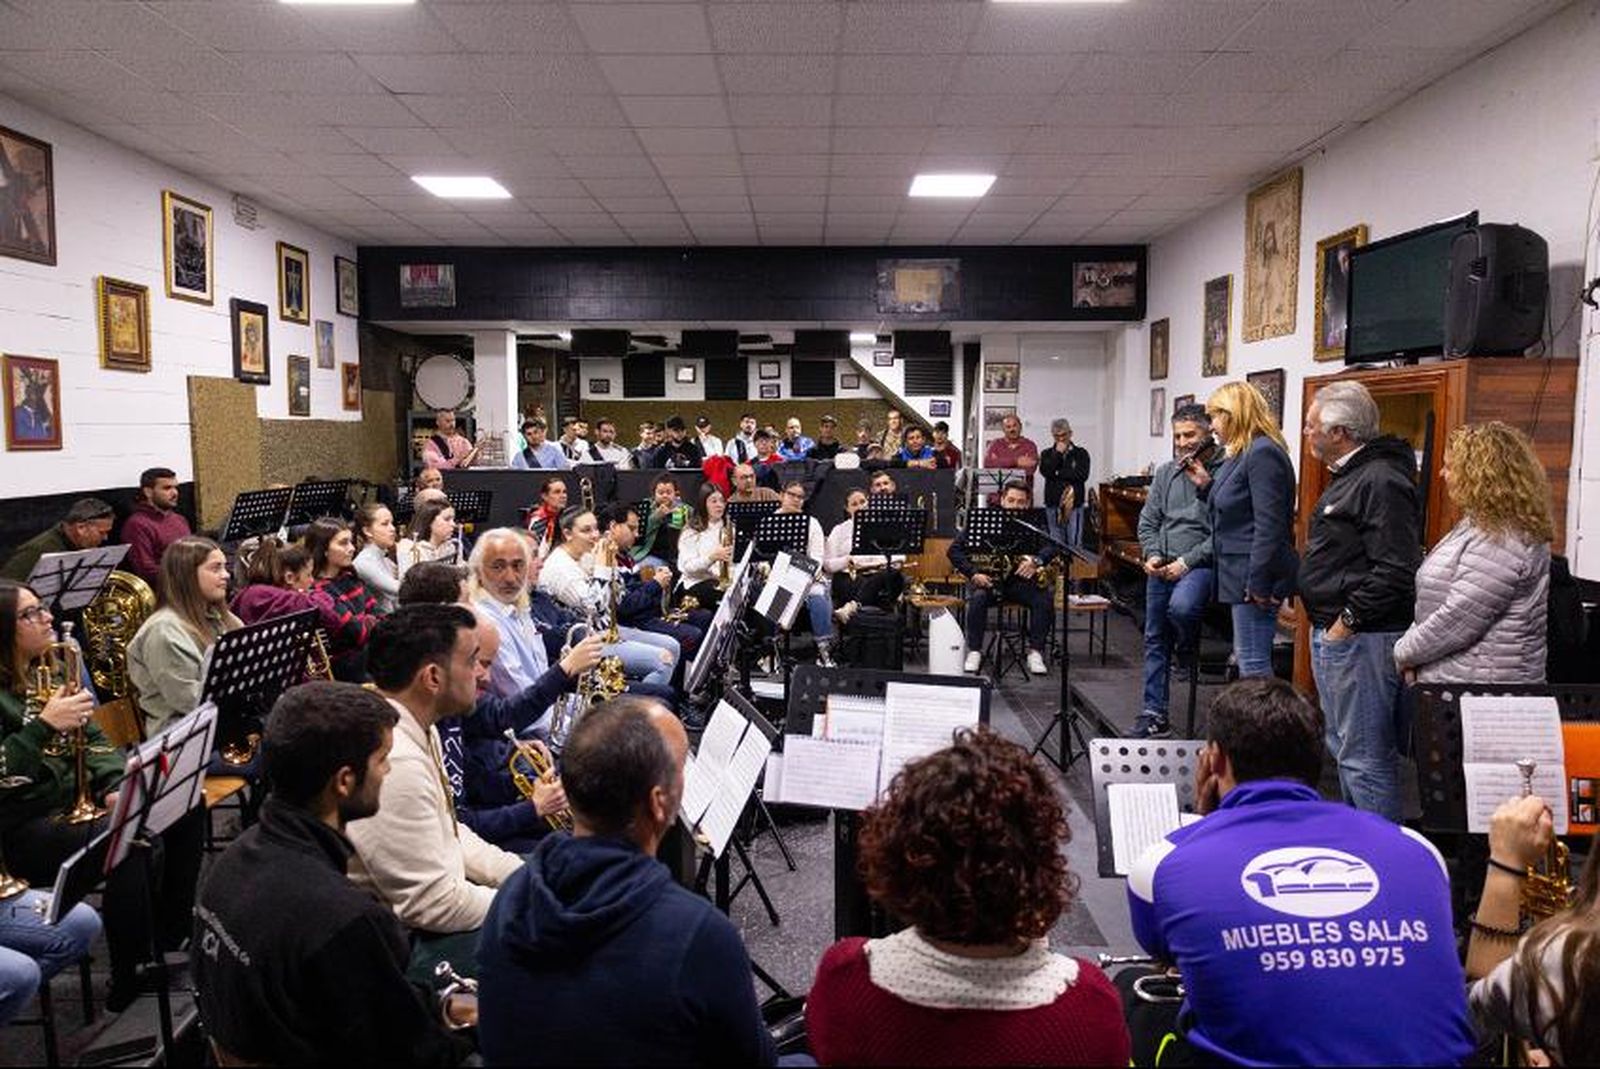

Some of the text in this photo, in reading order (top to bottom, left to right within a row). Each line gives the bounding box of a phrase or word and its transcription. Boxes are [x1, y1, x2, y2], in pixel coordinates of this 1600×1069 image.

[1221, 919, 1429, 951] MUEBLES SALAS
[1260, 946, 1405, 972] 959 830 975
